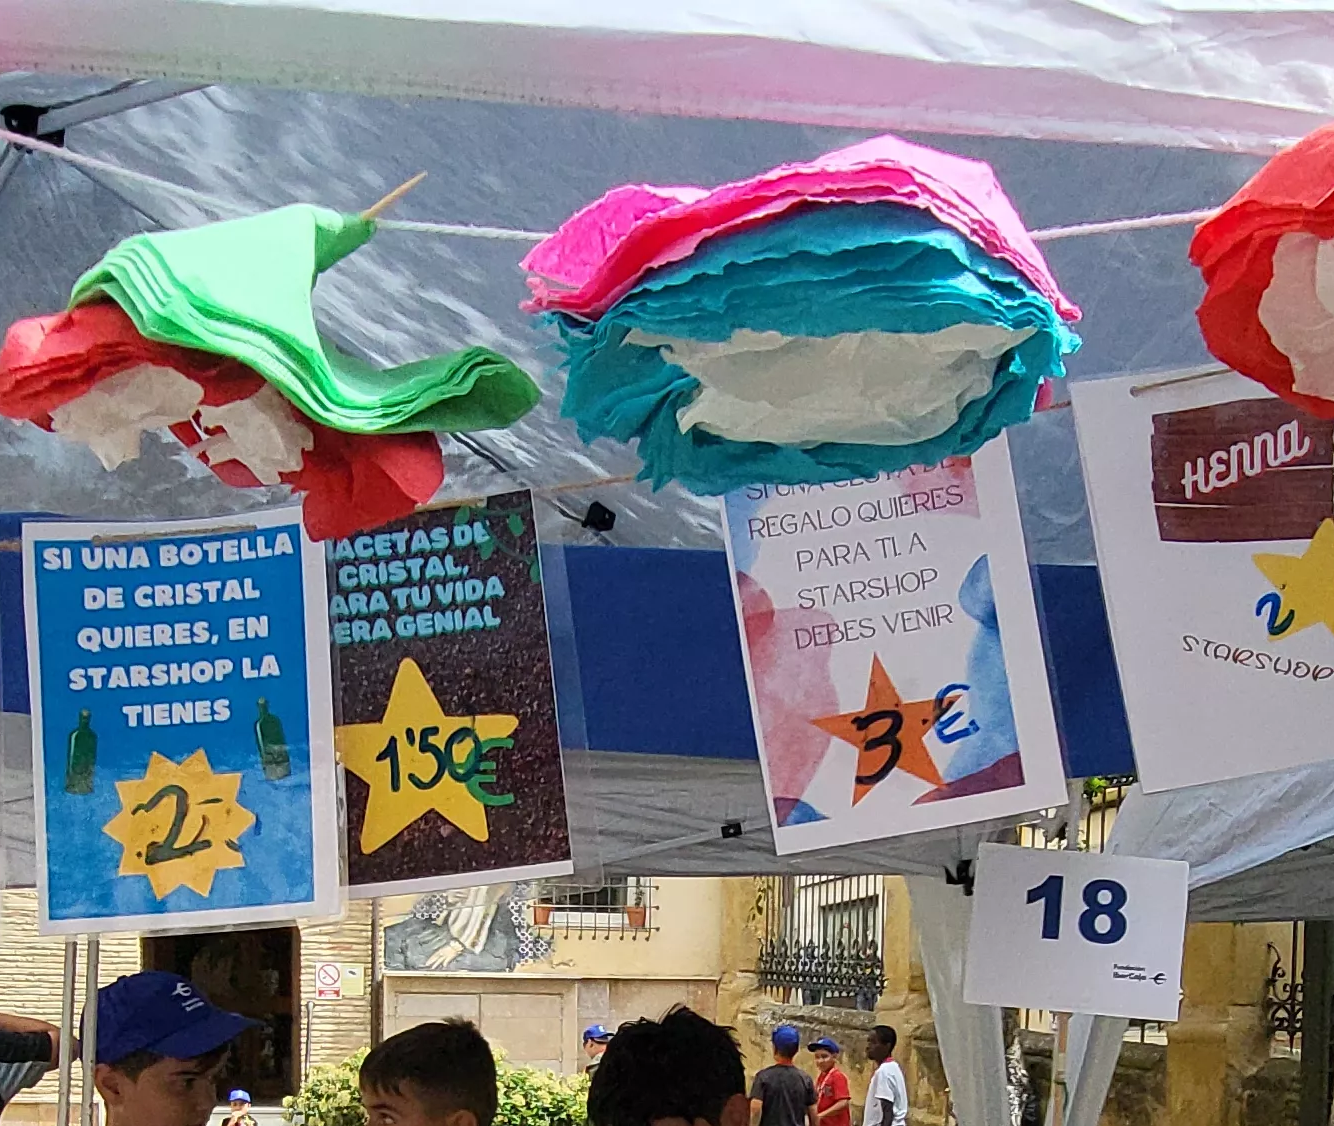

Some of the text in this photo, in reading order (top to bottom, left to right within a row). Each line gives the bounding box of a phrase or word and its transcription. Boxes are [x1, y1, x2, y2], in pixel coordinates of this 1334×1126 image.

[748, 484, 964, 541] REGALO QUIERES
[42, 532, 295, 571] SI UNA BOTELLA
[453, 518, 492, 548] DE
[795, 541, 870, 572] PARA
[908, 532, 927, 553] A
[83, 577, 260, 611] DE CRISTAL
[393, 585, 432, 611] TU
[434, 575, 506, 607] VIDA
[797, 567, 939, 611] STARSHOP
[76, 615, 268, 654] QUIERES, EN
[395, 605, 502, 640] GENIAL
[794, 603, 953, 650] DEBES VENIR
[68, 654, 280, 691] STARSHOP LA
[121, 698, 231, 727] TIENES
[1025, 875, 1128, 945] 18
